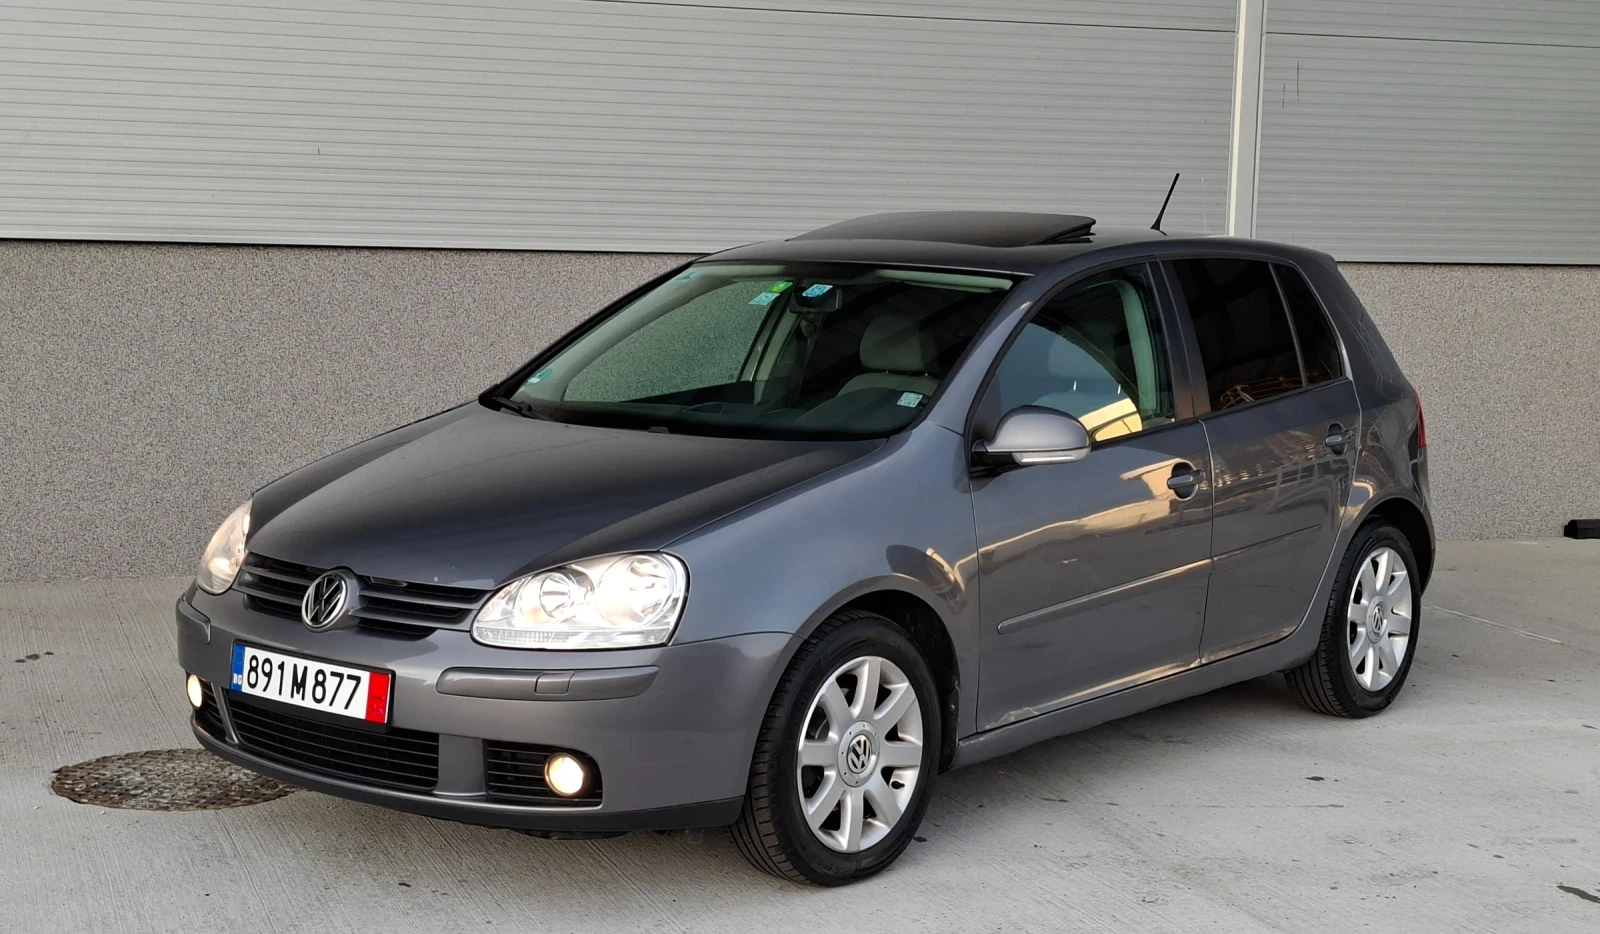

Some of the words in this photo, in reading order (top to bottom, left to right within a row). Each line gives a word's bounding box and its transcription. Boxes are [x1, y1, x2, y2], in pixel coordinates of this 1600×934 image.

[303, 572, 347, 628] VW
[233, 673, 243, 685] BG
[247, 655, 362, 710] 891M877
[847, 734, 872, 773] VW
